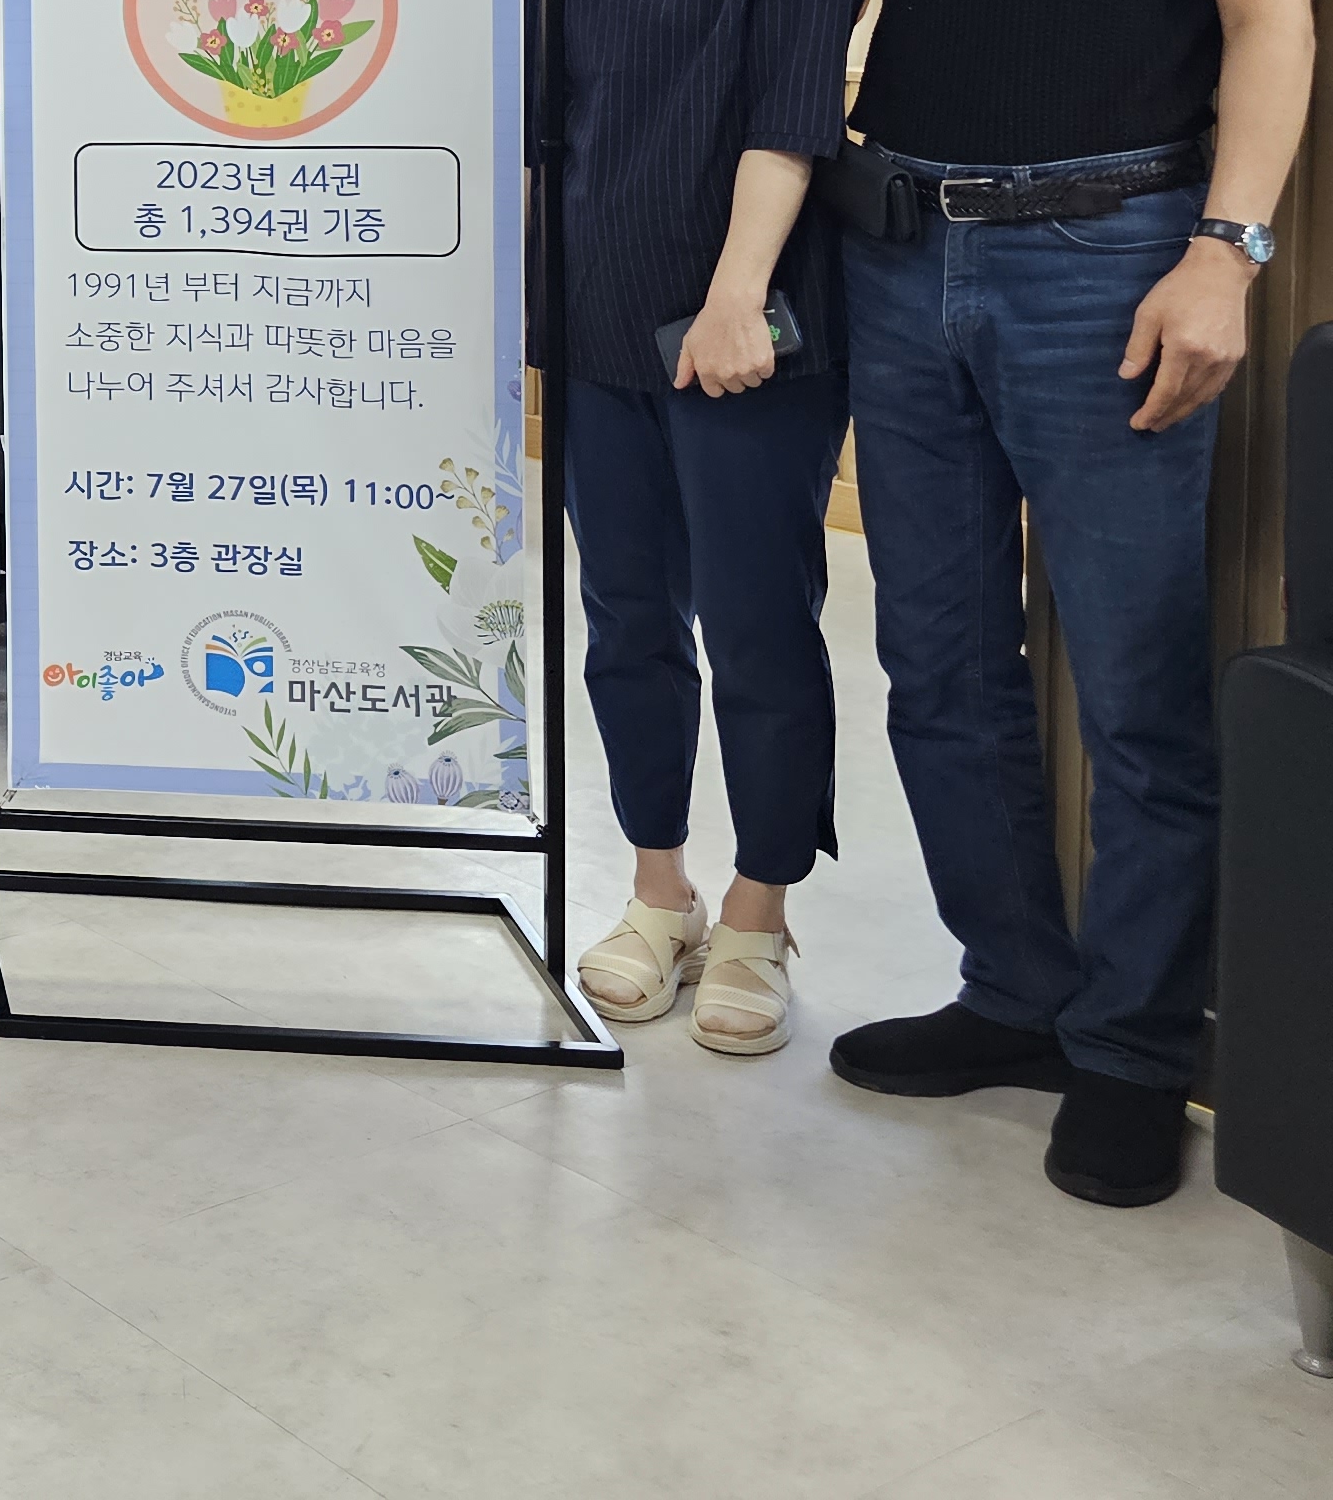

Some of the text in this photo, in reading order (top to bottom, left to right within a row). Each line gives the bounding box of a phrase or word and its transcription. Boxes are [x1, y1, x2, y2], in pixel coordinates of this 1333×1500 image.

[156, 160, 361, 197] 2023년 44권
[133, 203, 387, 244] 총 1,394권 기증
[66, 272, 373, 308] 1991년 부터 지금까지
[65, 321, 457, 361] 소중한 지식과 따뜻한 마음을
[66, 371, 425, 410] 나누어 주셔서 감사합니다.
[65, 470, 455, 511] 시간: 7월 27일(목) 11:00~
[67, 539, 305, 577] 장소: 3층 관장실
[223, 609, 249, 618] MASAN
[249, 612, 274, 629] PUBLIC
[103, 651, 143, 662] 경남교육
[288, 658, 386, 678] 경상남도교육청
[43, 658, 165, 701] 아이좋아
[288, 681, 457, 719] 마산도서관
